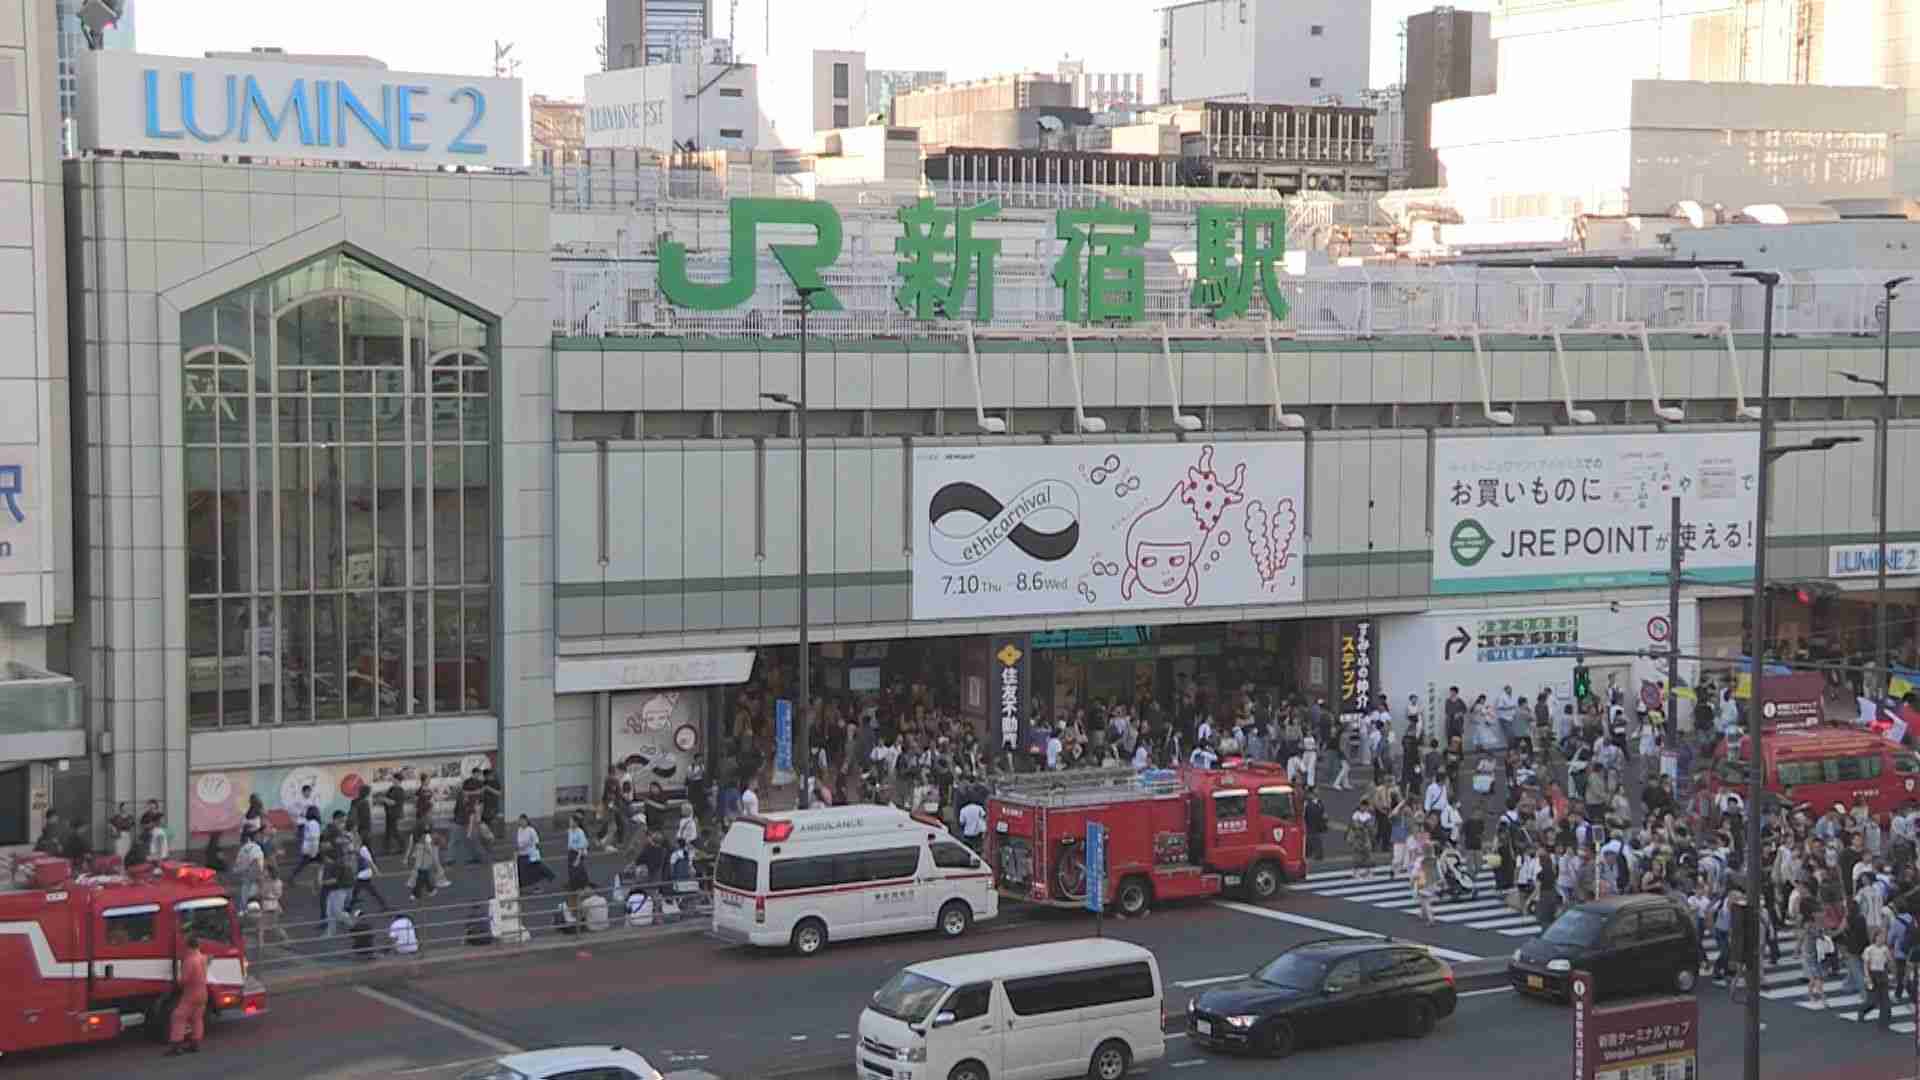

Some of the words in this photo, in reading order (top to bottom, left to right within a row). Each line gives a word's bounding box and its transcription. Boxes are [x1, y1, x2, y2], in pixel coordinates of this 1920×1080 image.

[143, 68, 430, 151] LUMINE
[447, 86, 488, 154] 2
[657, 198, 844, 312] JR
[895, 197, 1292, 322] 新宿駅
[1450, 475, 1601, 508] お買いものに
[962, 485, 1052, 561] ethicarnival
[1500, 528, 1556, 558] JRE
[1564, 525, 1653, 555] POINT
[942, 575, 979, 595] 7.10
[1016, 571, 1043, 592] 8.6
[1044, 577, 1069, 592] Wed
